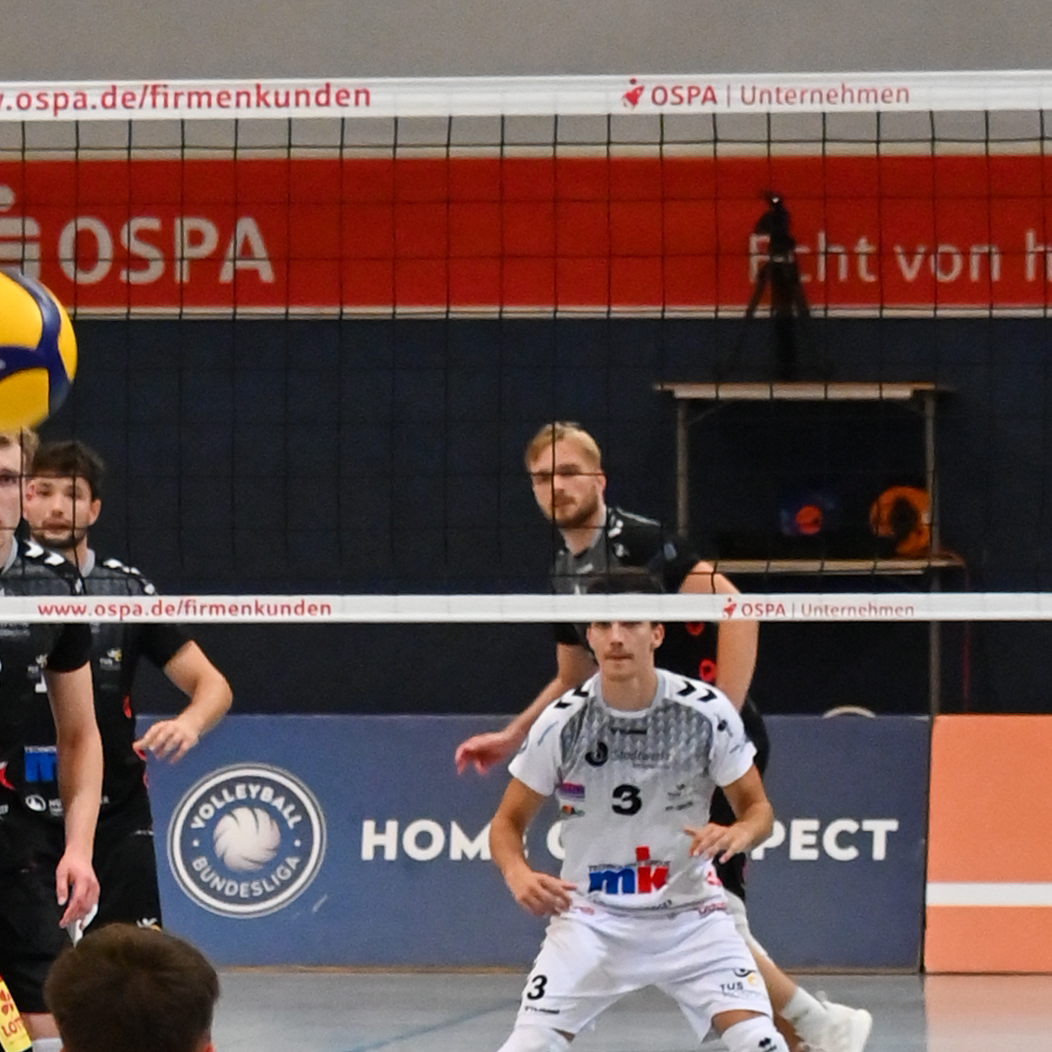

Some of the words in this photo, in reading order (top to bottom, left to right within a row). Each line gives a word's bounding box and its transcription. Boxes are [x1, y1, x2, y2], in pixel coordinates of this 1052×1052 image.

[650, 84, 718, 106] OSPA
[740, 82, 910, 106] Unternehmen
[57, 215, 276, 286] OSPA
[893, 242, 1001, 283] von
[37, 599, 332, 621] www.ospa.de/firmenkunden
[740, 602, 786, 617] OSPA
[800, 602, 915, 617] Unternehmen
[189, 783, 304, 831] VOLLEYBALL
[611, 783, 643, 816] 3
[360, 819, 529, 861] HOM
[192, 855, 301, 898] BUNDESLIGA
[526, 974, 548, 1001] 3
[720, 981, 744, 993] TUS
